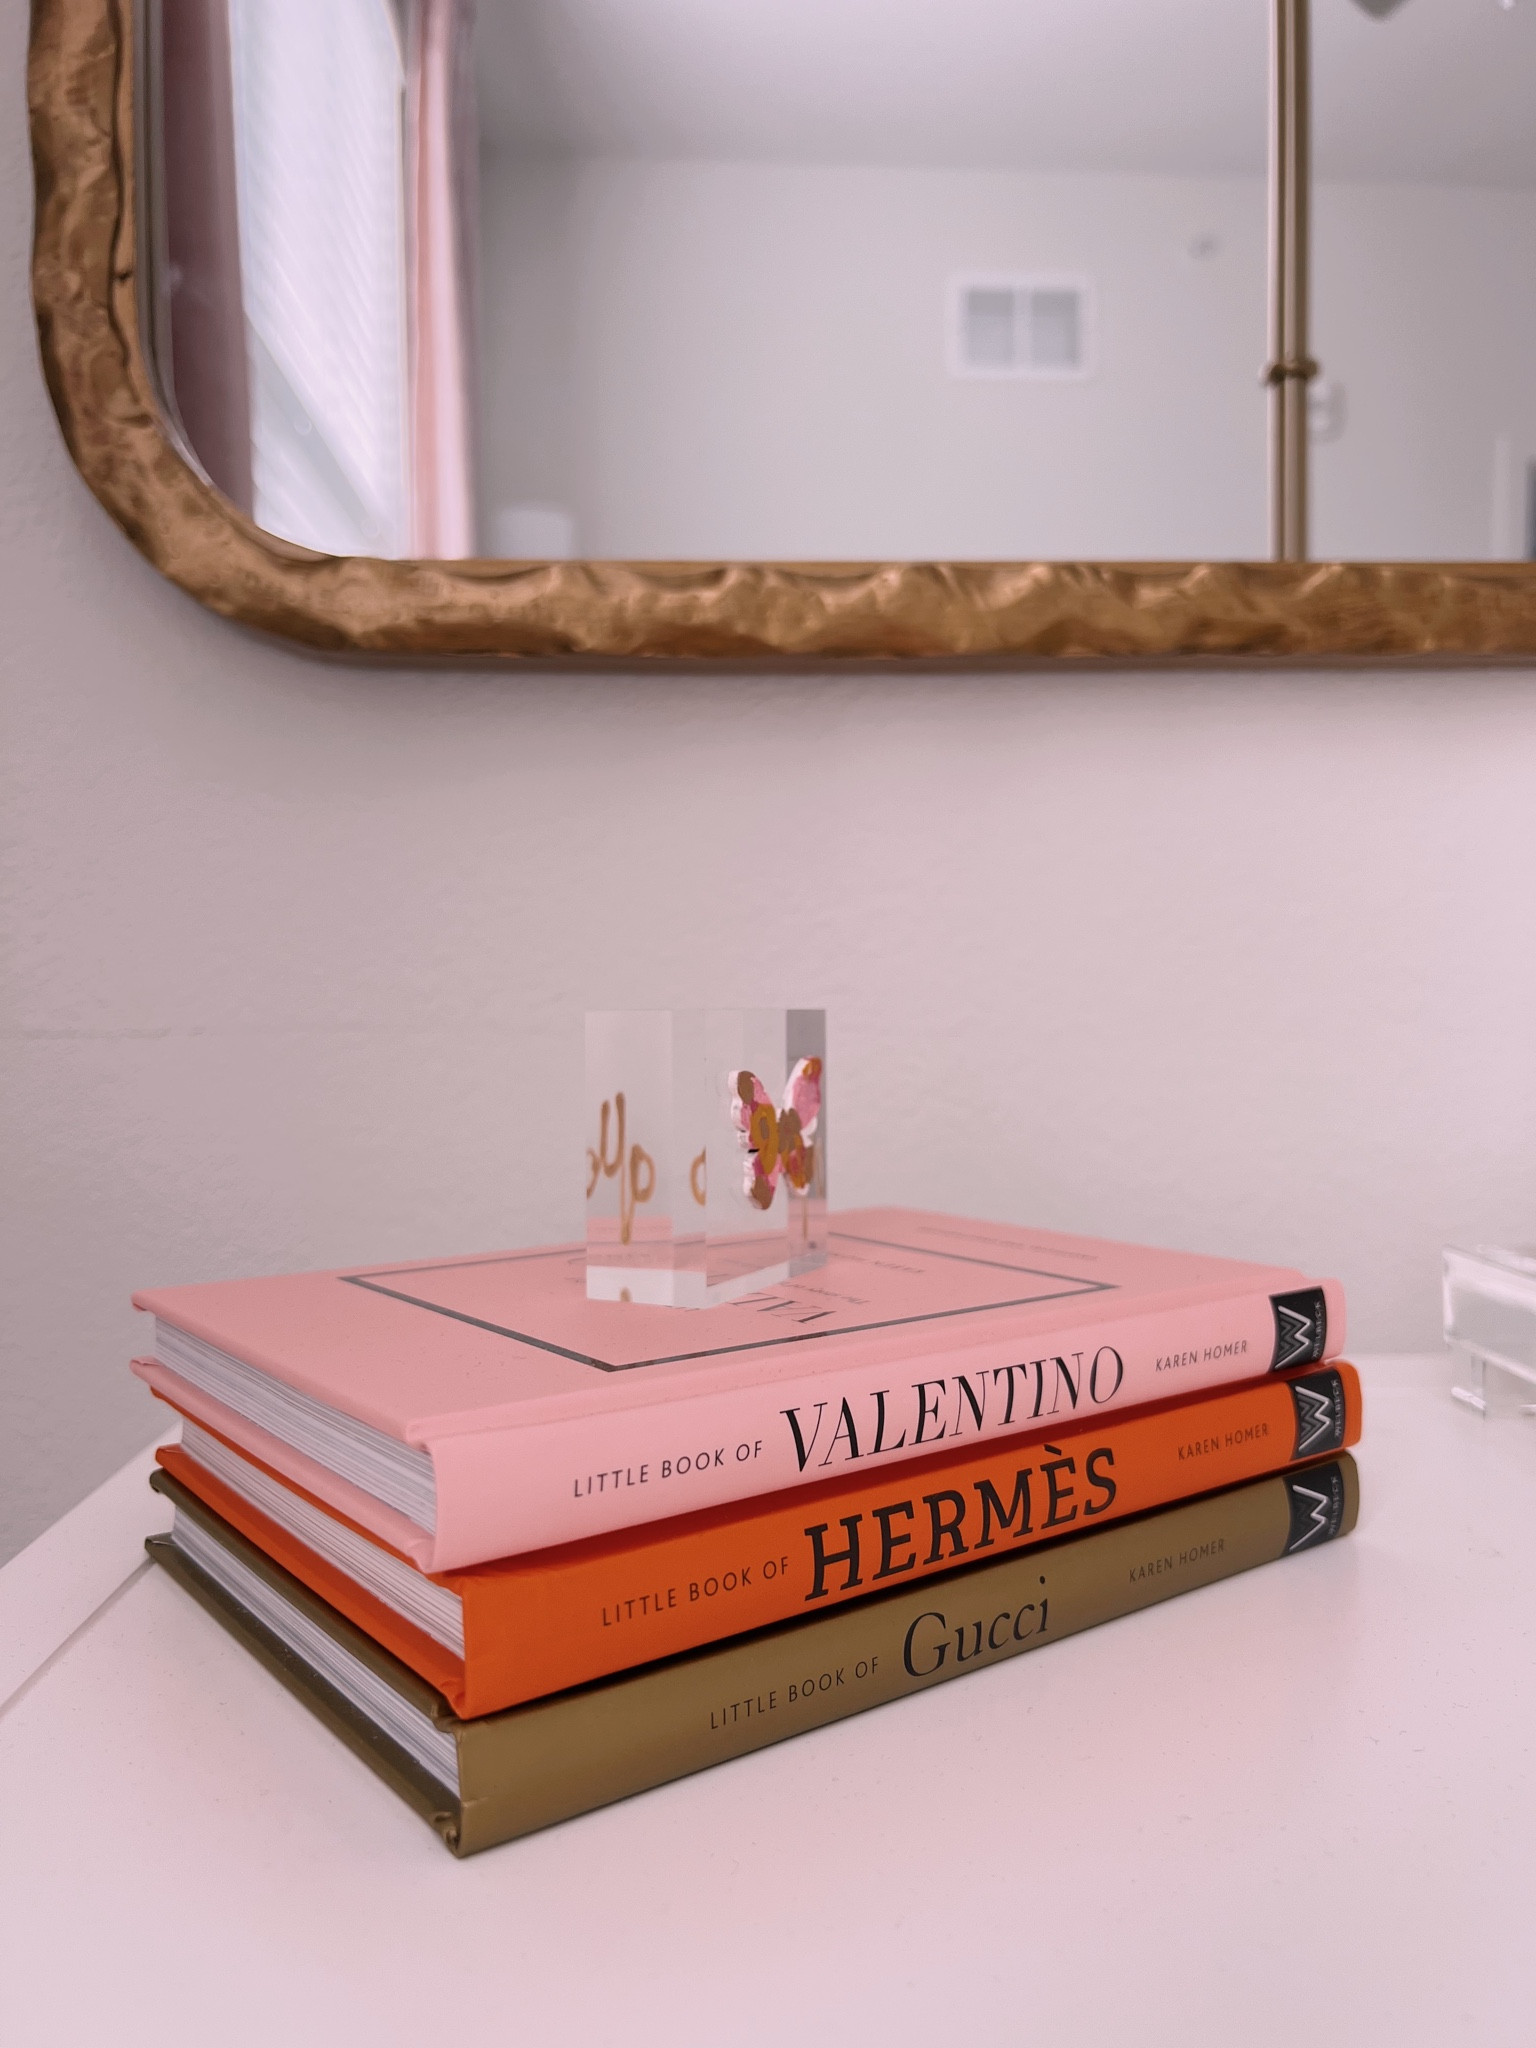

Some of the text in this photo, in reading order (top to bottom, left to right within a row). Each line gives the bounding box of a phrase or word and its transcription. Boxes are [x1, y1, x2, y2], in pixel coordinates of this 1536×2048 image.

[1155, 1339, 1247, 1372] KAREN HOMER
[574, 1346, 1124, 1498] LITTLE BOOK OF VALENTINO
[1177, 1422, 1268, 1461] KAREN HOMER
[602, 1443, 1117, 1627] LITTLE BOOK OF HERMÈS
[1129, 1538, 1225, 1584] KAREN HOMER
[710, 1575, 1049, 1730] LITTLE BOOK OF Gucci
